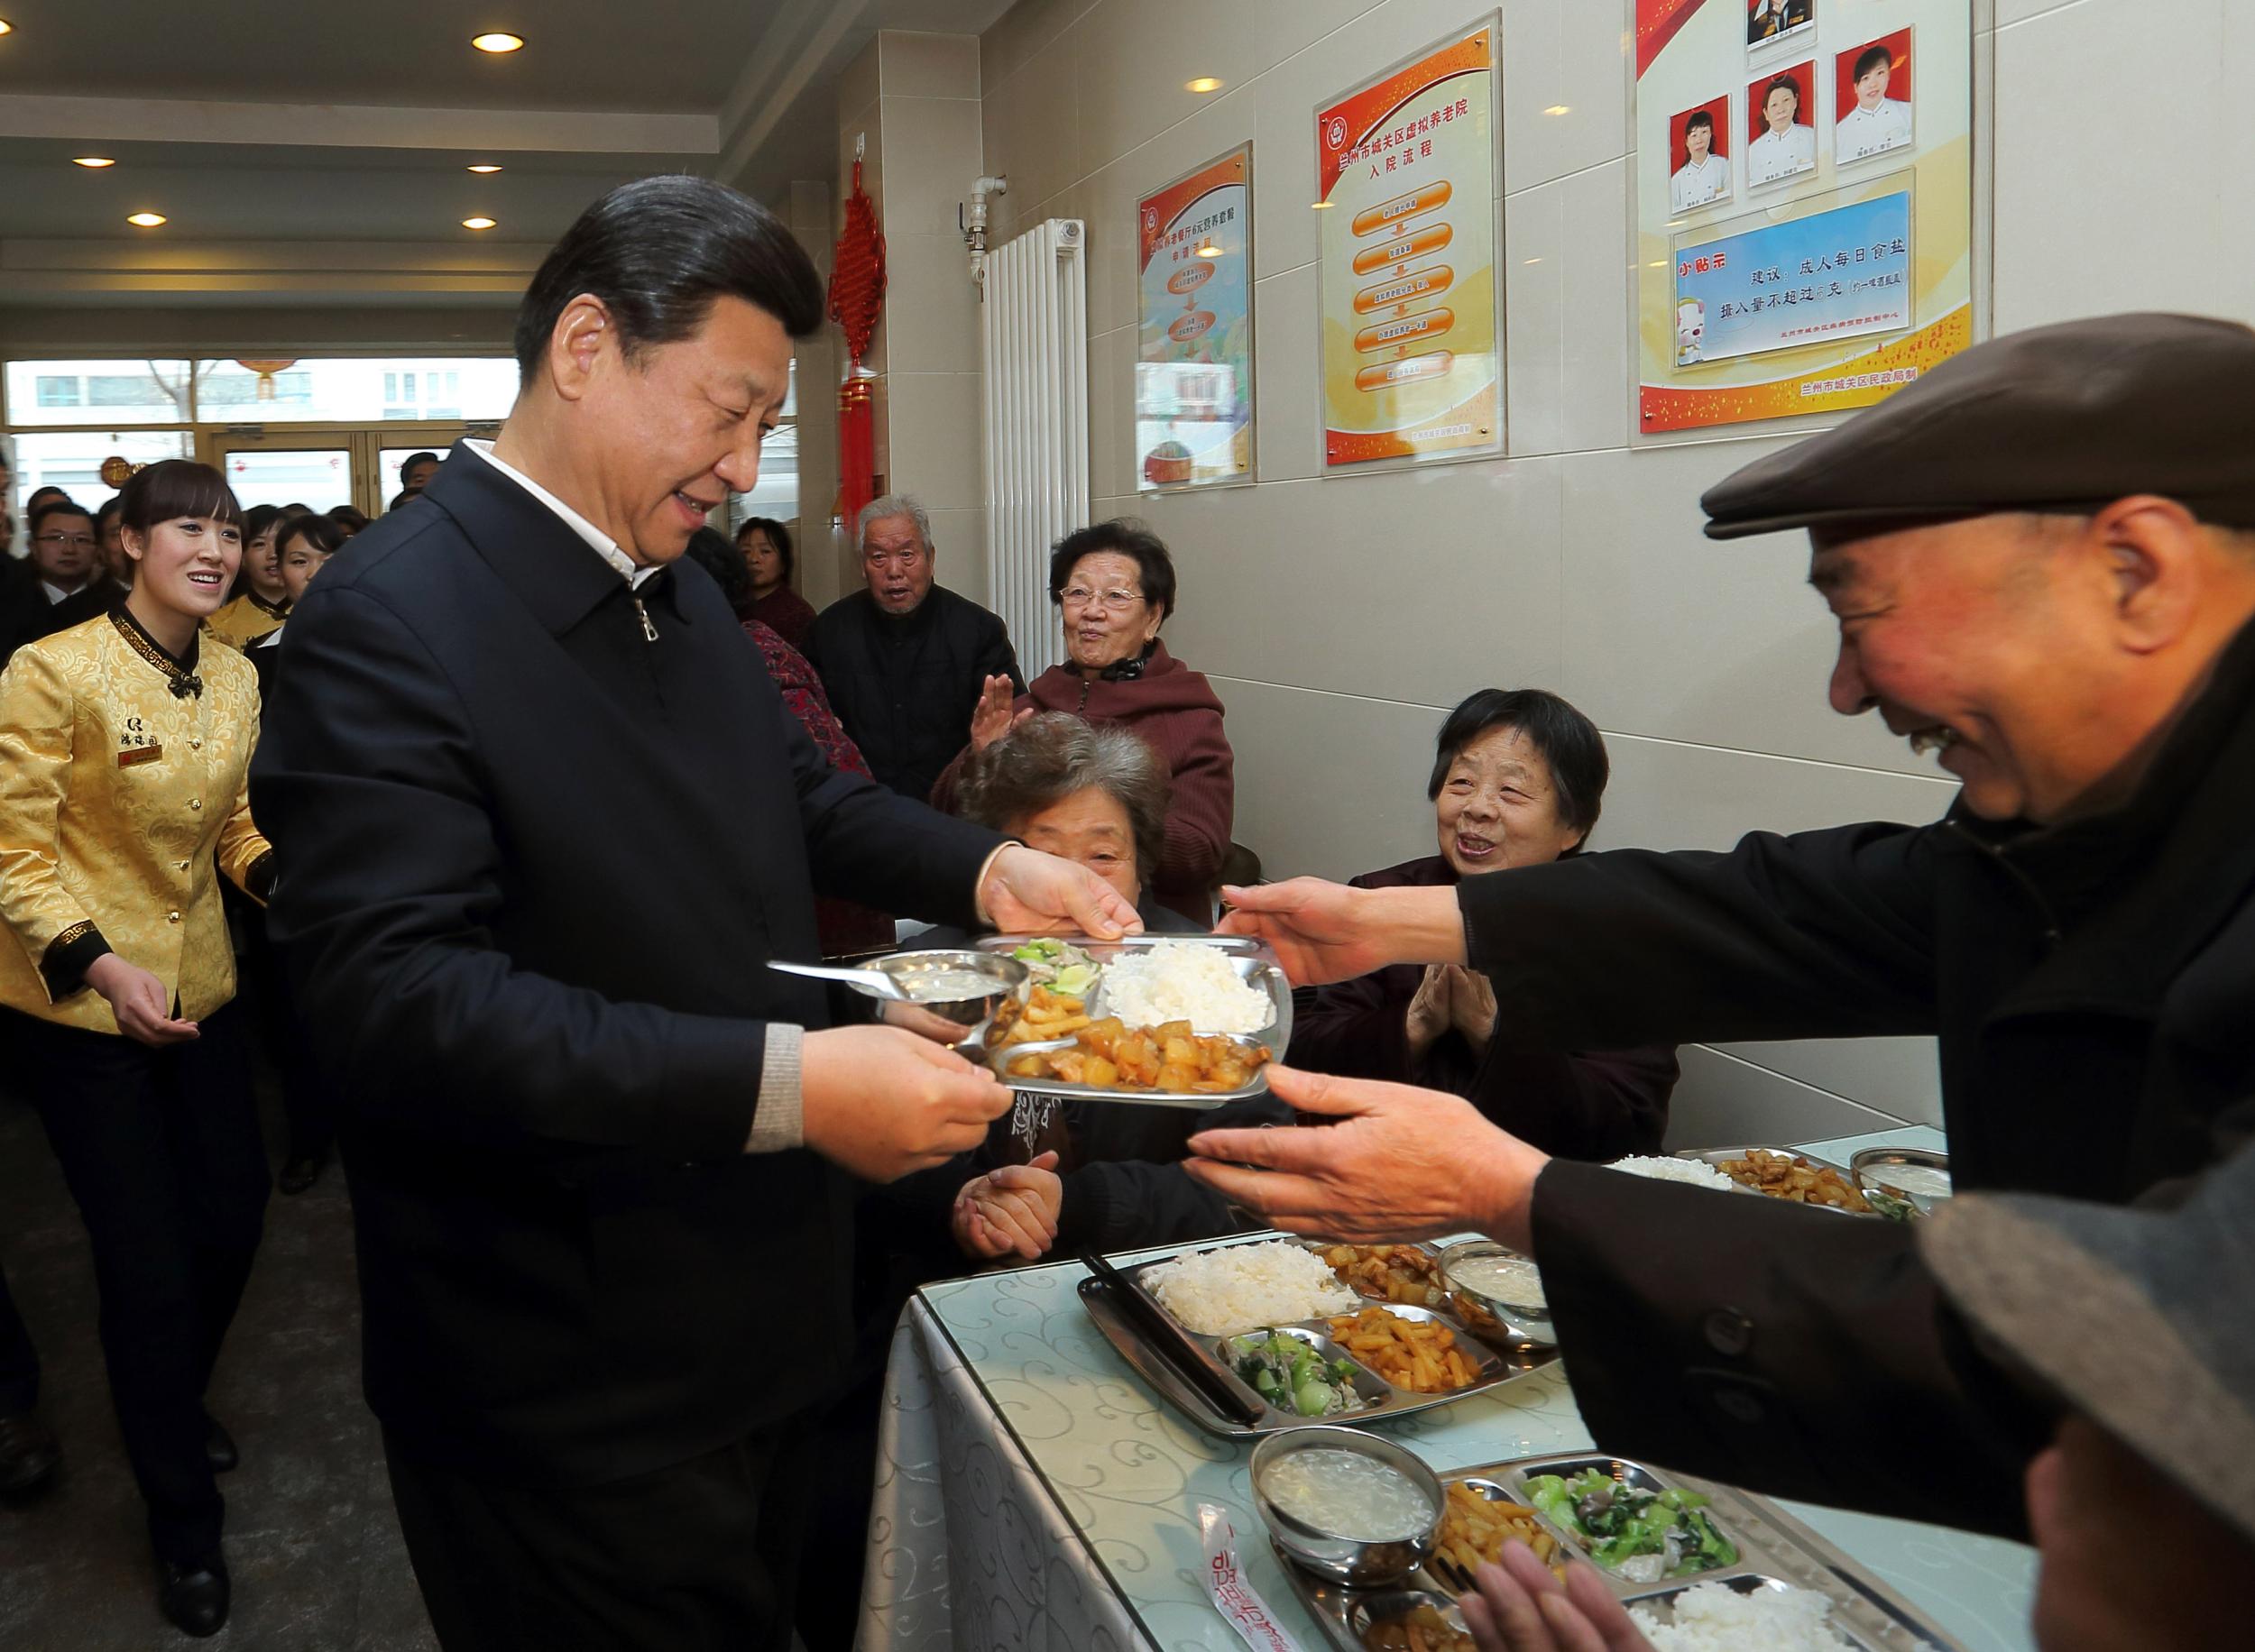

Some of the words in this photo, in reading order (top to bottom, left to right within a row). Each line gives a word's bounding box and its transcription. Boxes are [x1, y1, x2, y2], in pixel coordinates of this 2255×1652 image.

[1339, 98, 1468, 171] 兰州市城关区虚拟养老院
[1369, 140, 1432, 179] 入院流程
[1679, 252, 1726, 277] 小贴示
[1801, 367, 1918, 395] 兰州市城关区民政局制
